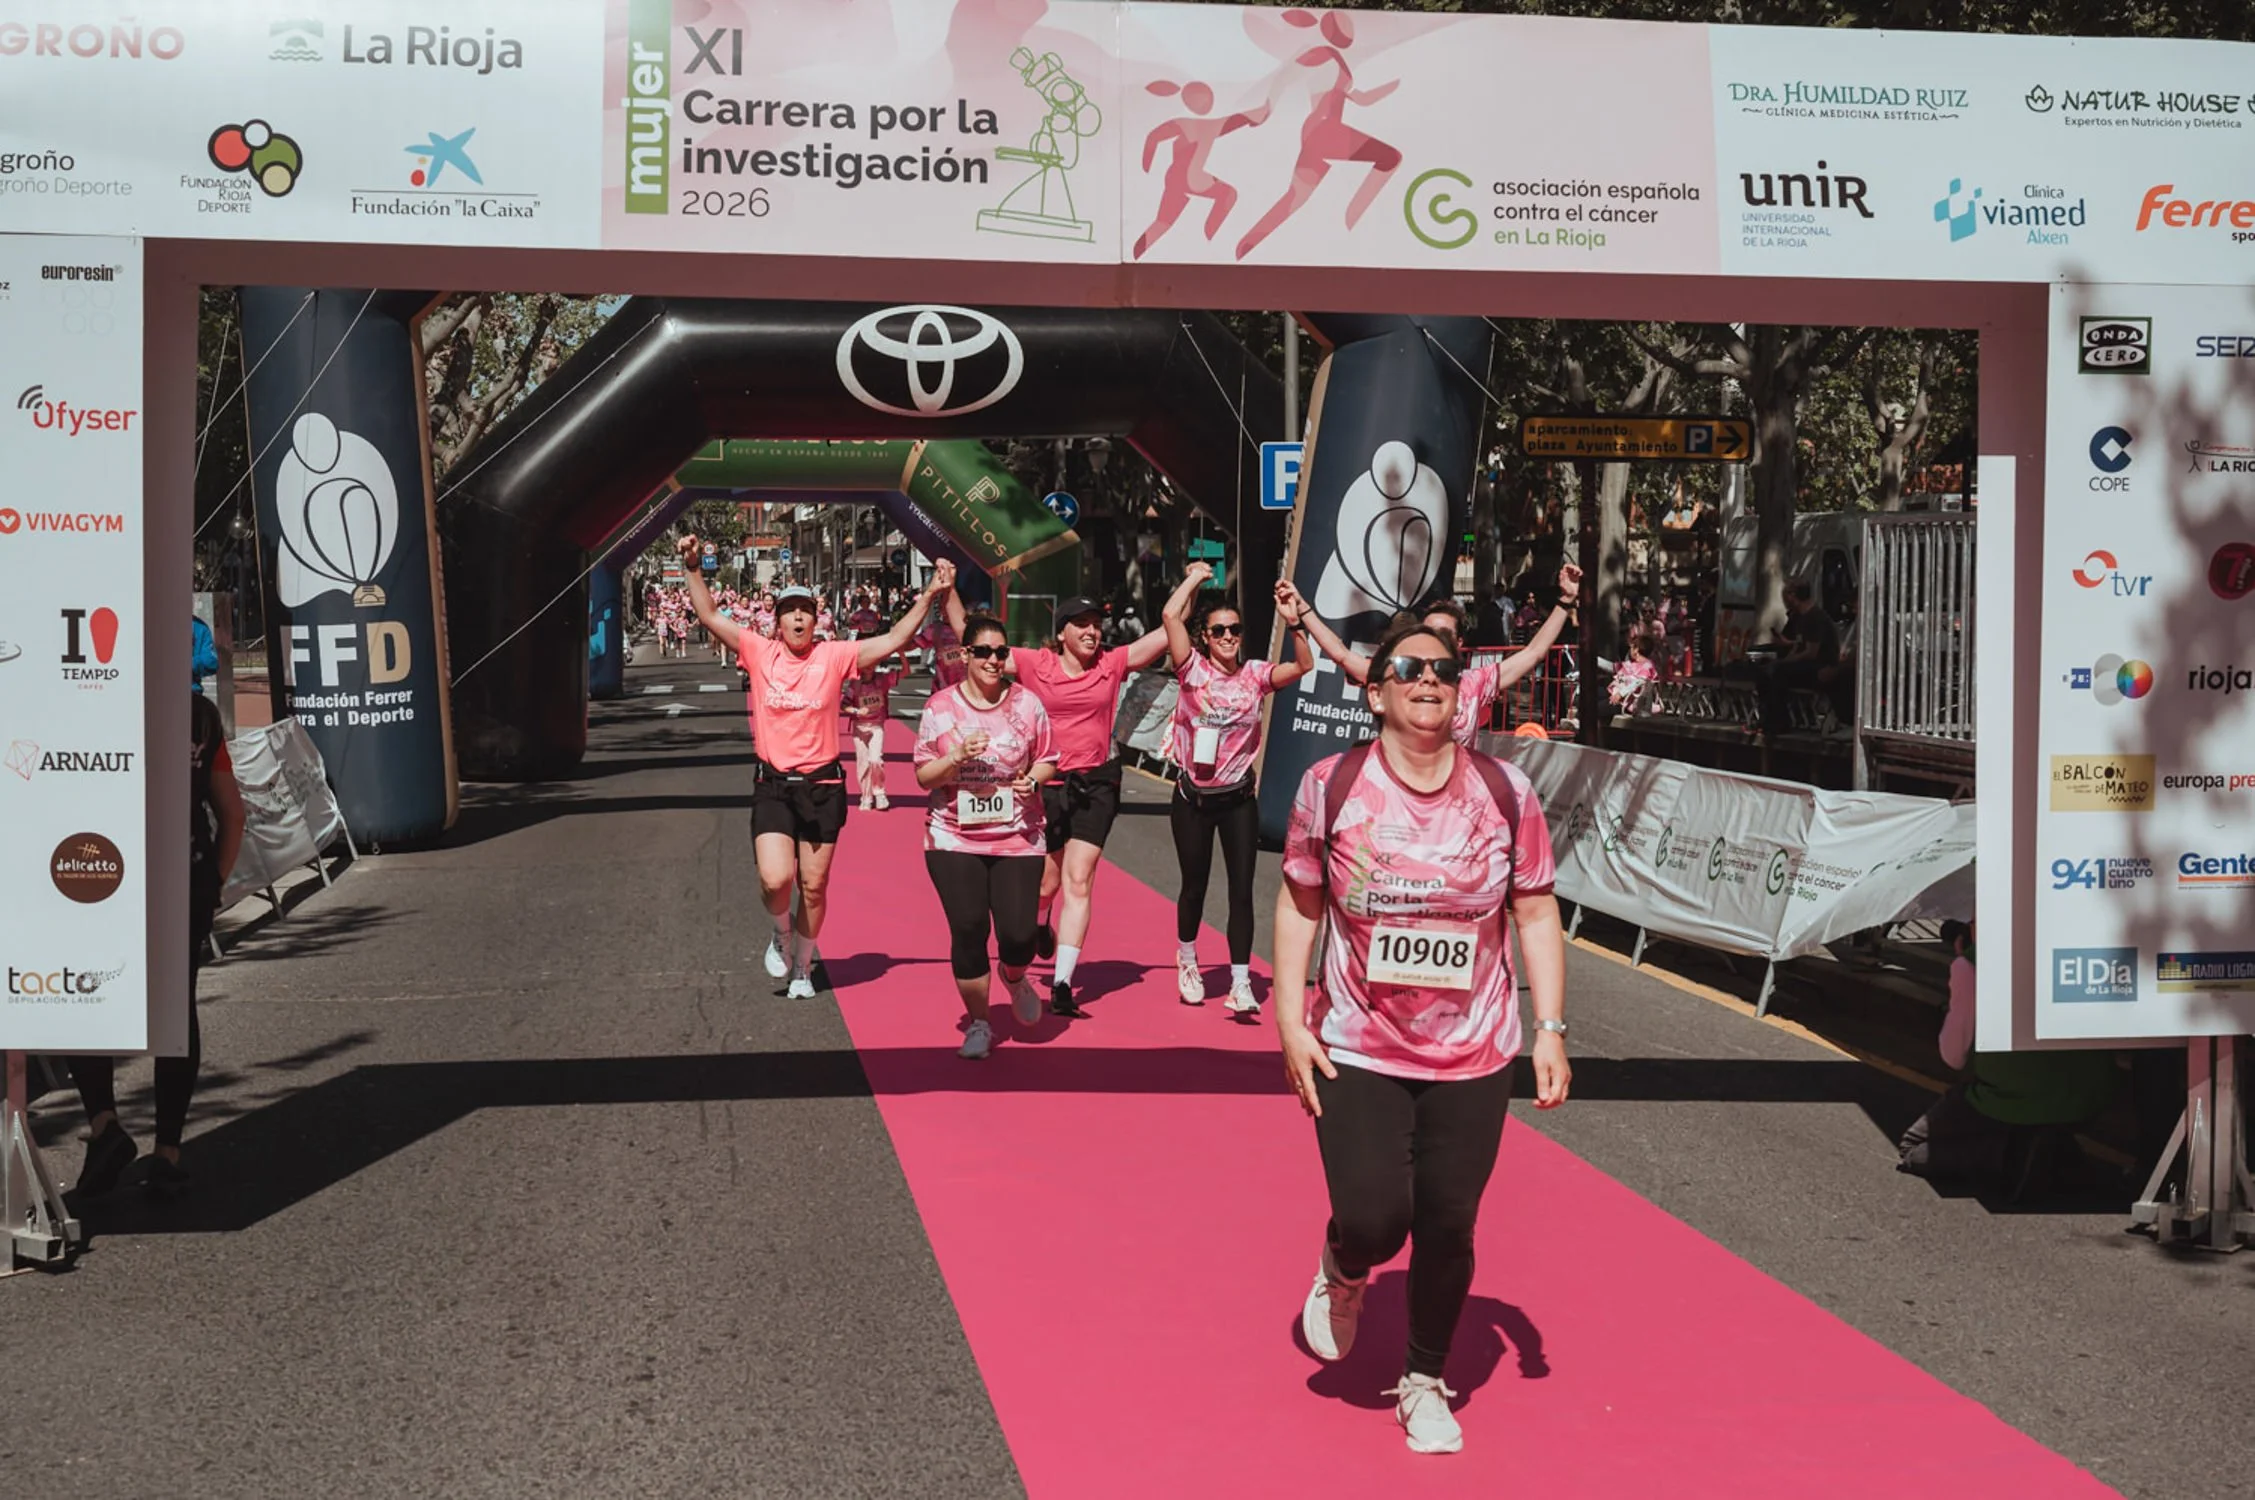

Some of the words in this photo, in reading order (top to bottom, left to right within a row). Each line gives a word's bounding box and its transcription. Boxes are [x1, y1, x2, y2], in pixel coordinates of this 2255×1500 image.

[0, 16, 184, 60] GROÑO
[343, 24, 392, 63] La
[406, 25, 523, 75] Rioja
[683, 26, 742, 76] XI
[1783, 81, 1910, 106] HUMILDAD
[1916, 89, 1969, 110] RUIZ
[2061, 90, 2150, 112] NATUR
[2157, 92, 2241, 113] HOUSE
[621, 42, 672, 196] mujer
[683, 89, 856, 130] Carrera
[870, 106, 946, 139] por
[958, 99, 998, 135] la
[1766, 106, 1815, 118] CLÍNICA
[1820, 108, 1880, 120] MEDICINA
[1884, 110, 1938, 121] ESTÉTICA
[2064, 116, 2113, 128] Expertos
[2131, 117, 2182, 128] Nutrición
[2184, 121, 2191, 129] y
[2194, 118, 2242, 129] Dietética
[0, 150, 75, 174] groño
[683, 137, 989, 188] investigación
[54, 177, 133, 197] Deporte
[219, 188, 252, 201] RIOJA
[1493, 179, 1601, 197] asociación
[1608, 183, 1700, 203] española
[2024, 184, 2065, 199] Clínica
[198, 200, 252, 213] DEPORTE
[351, 197, 450, 216] Fundación
[682, 188, 771, 218] 2026
[1983, 199, 2086, 227] viamed
[1494, 204, 1560, 221] contra
[1566, 204, 1583, 221] el
[1589, 205, 1658, 223] cáncer
[1742, 213, 1816, 223] UNIVERSIDAD
[1494, 230, 1519, 244] en
[1526, 228, 1550, 245] La
[1556, 228, 1606, 250] Rioja
[1742, 224, 1832, 236] INTERNACIONAL
[1743, 237, 1757, 246] DE
[1760, 237, 1775, 247] LA
[1777, 237, 1808, 248] RIOJA
[2091, 330, 2139, 341] ONDA
[2093, 350, 2138, 362] CERO
[1528, 438, 1566, 451] plaza
[1576, 439, 1678, 454] Ayuntamiento
[1689, 428, 1708, 452] P
[1274, 450, 1301, 501] P
[2211, 461, 2230, 473] LA
[2089, 477, 2130, 491] COPE
[920, 466, 1008, 557] PITILLOS
[26, 512, 124, 532] VIVAGYM
[2111, 571, 2153, 596] tvr
[61, 608, 86, 664] I
[280, 621, 412, 687] FFD
[61, 668, 119, 681] TEMPLO
[285, 692, 360, 709] Fundación
[365, 690, 413, 706] Ferrer
[288, 714, 316, 727] ara
[324, 711, 340, 726] el
[348, 707, 414, 727] Deporte
[1295, 697, 1374, 723] Fundación
[1292, 717, 1328, 735] para
[1335, 724, 1351, 739] el
[1359, 726, 1379, 740] De
[39, 752, 135, 772] ARNAUT
[2063, 762, 2126, 780] BALCÓN
[2105, 780, 2149, 795] MATEO
[2164, 775, 2225, 791] europa
[968, 796, 1003, 813] 1510
[57, 858, 117, 872] delicatto
[2109, 857, 2151, 868] nueve
[1370, 869, 1443, 889] Carrera
[2051, 858, 2106, 889] 941
[2108, 868, 2153, 878] cuatro
[2109, 878, 2135, 889] uno
[1367, 891, 1400, 905] por
[1405, 893, 1423, 904] la
[1377, 934, 1470, 968] 10908
[9, 966, 102, 994] tacto
[2059, 956, 2082, 985] El
[2087, 957, 2132, 985] Día
[2193, 964, 2225, 978] RADIO
[2085, 985, 2097, 994] de
[2099, 985, 2109, 994] La
[2111, 984, 2134, 995] Rioja
[8, 996, 67, 1004] DEPILACIÓN
